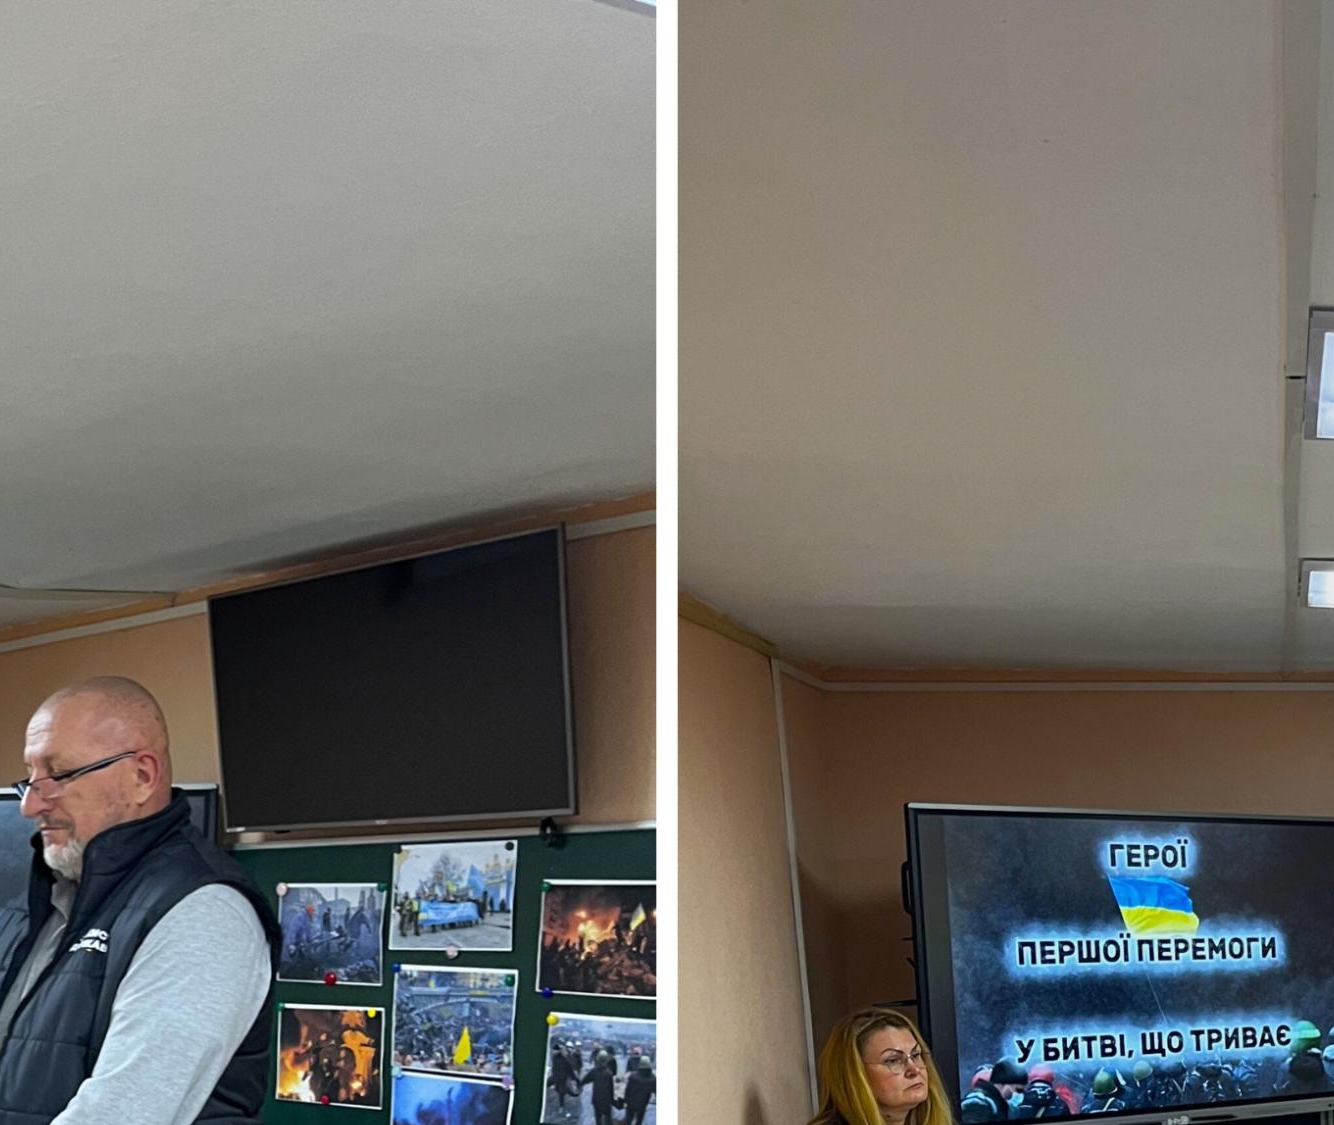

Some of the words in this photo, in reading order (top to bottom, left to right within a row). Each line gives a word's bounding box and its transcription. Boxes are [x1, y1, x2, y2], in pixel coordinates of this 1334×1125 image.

[1110, 839, 1188, 868] ГЕРОЇ
[1018, 933, 1131, 965] ПЕРШОЇ
[1137, 937, 1276, 962] ПЕРЕМОГИ
[1016, 1039, 1035, 1063] У
[1043, 1034, 1134, 1061] БИТВІ,
[1141, 1031, 1183, 1057] ЩО
[1190, 1025, 1291, 1051] ТРИВАЄ
